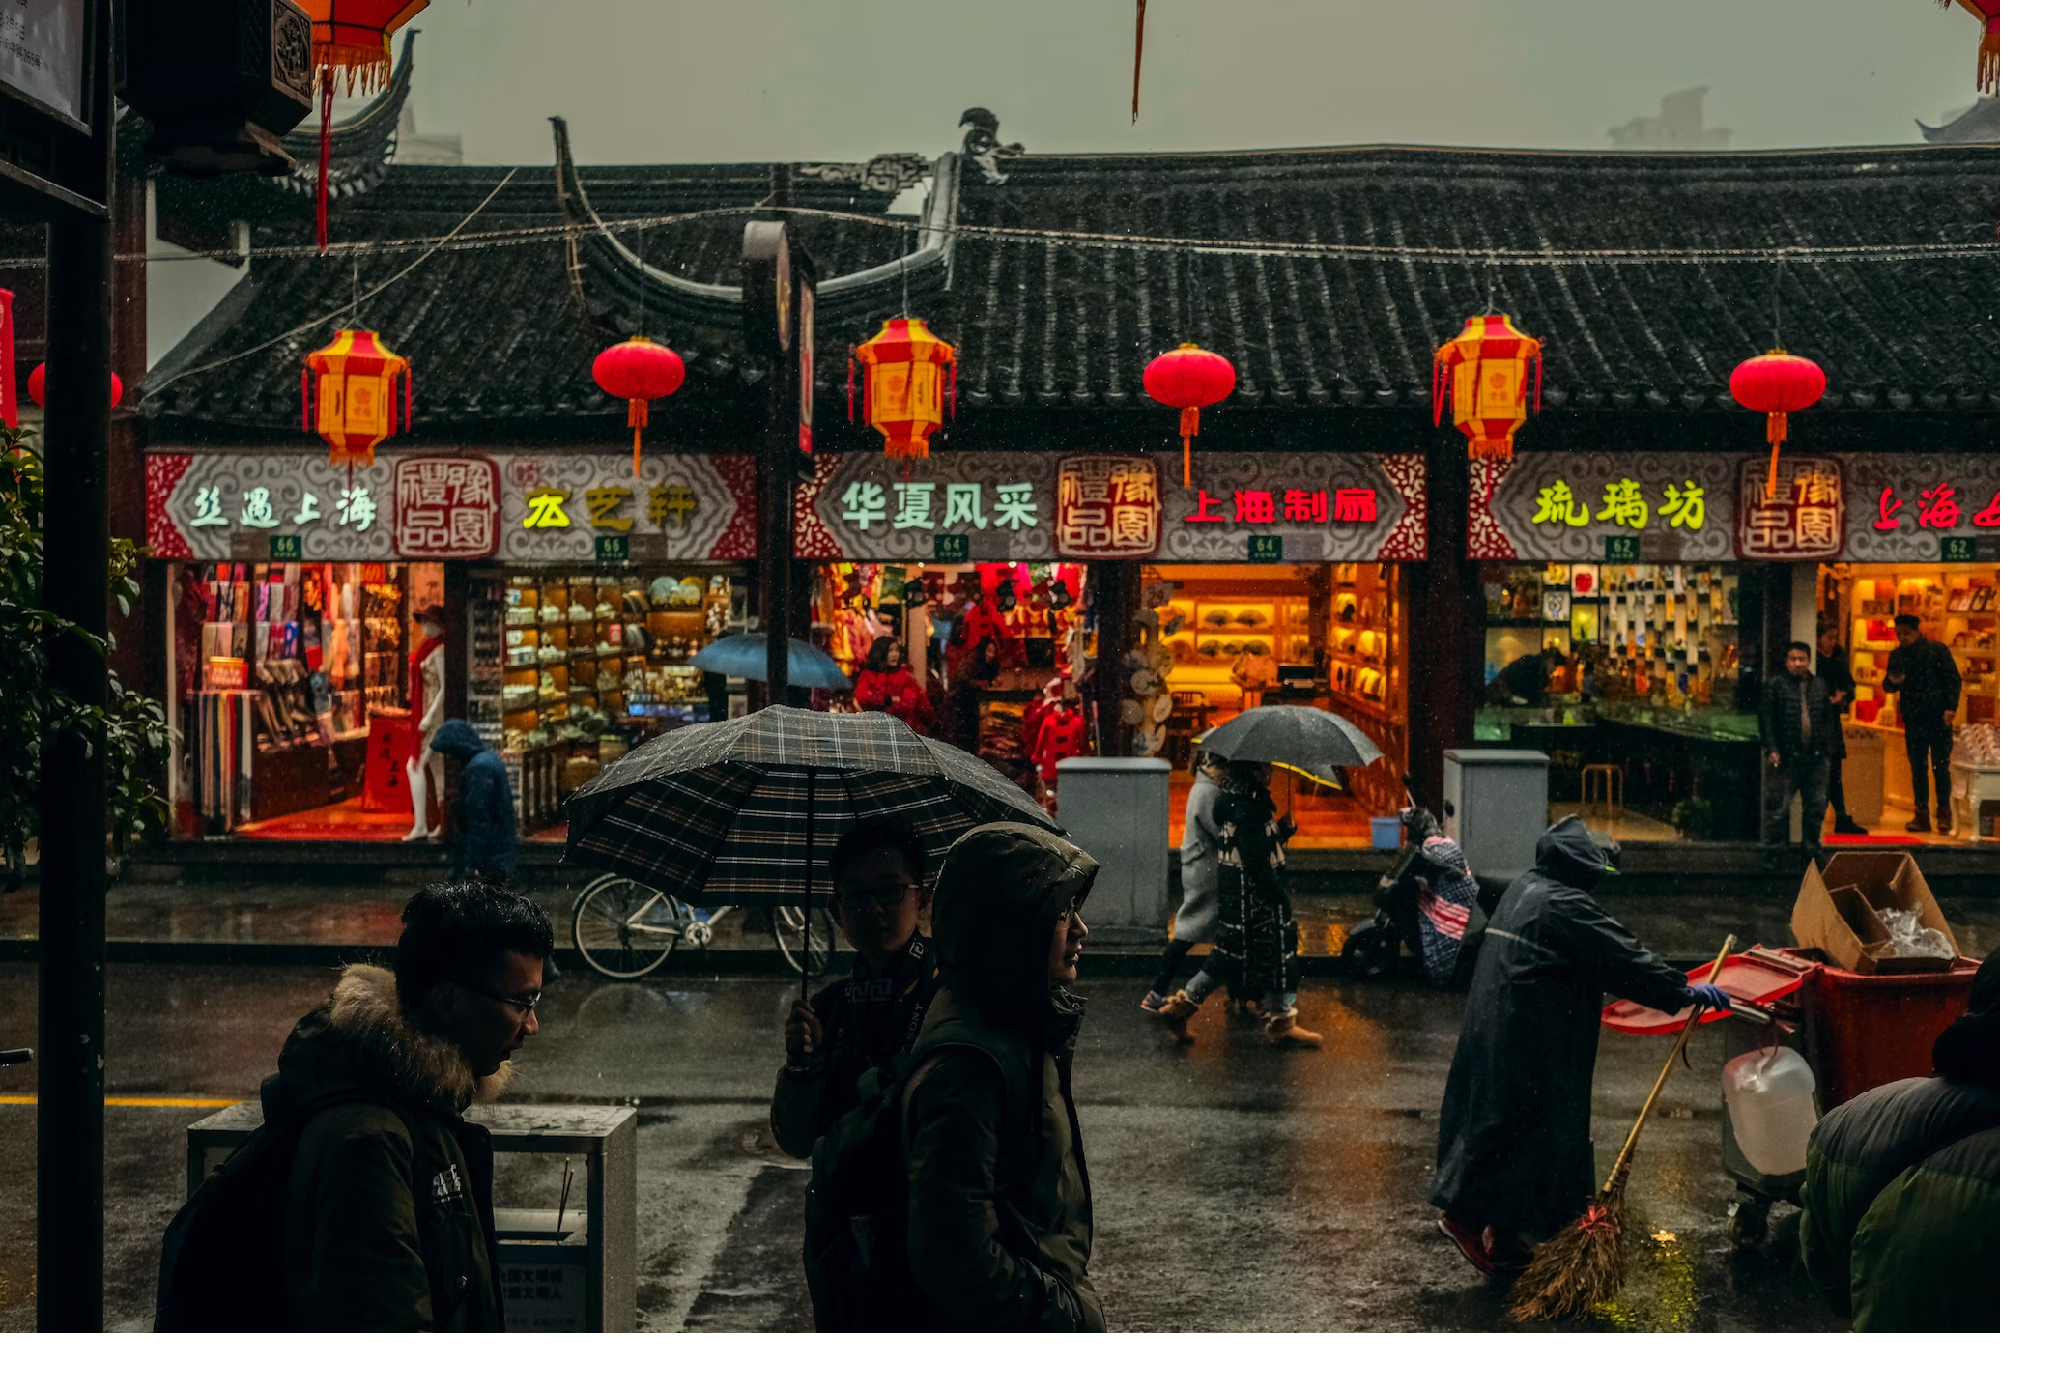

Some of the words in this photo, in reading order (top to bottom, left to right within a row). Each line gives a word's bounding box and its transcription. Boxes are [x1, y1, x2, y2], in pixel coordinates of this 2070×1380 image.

[190, 485, 377, 531] 丝遇上海
[523, 484, 696, 531] 宏艺轩
[841, 481, 1039, 530] 华夏风采
[1184, 487, 1377, 523] 上海制扇
[1532, 478, 1705, 529] 琉璃坊
[277, 537, 295, 552] 66
[604, 538, 620, 553] 66
[944, 537, 960, 551] 64
[1256, 537, 1273, 552] 64
[1614, 538, 1632, 553] 62
[1950, 540, 1967, 553] 62
[905, 1002, 923, 1041] SONY
